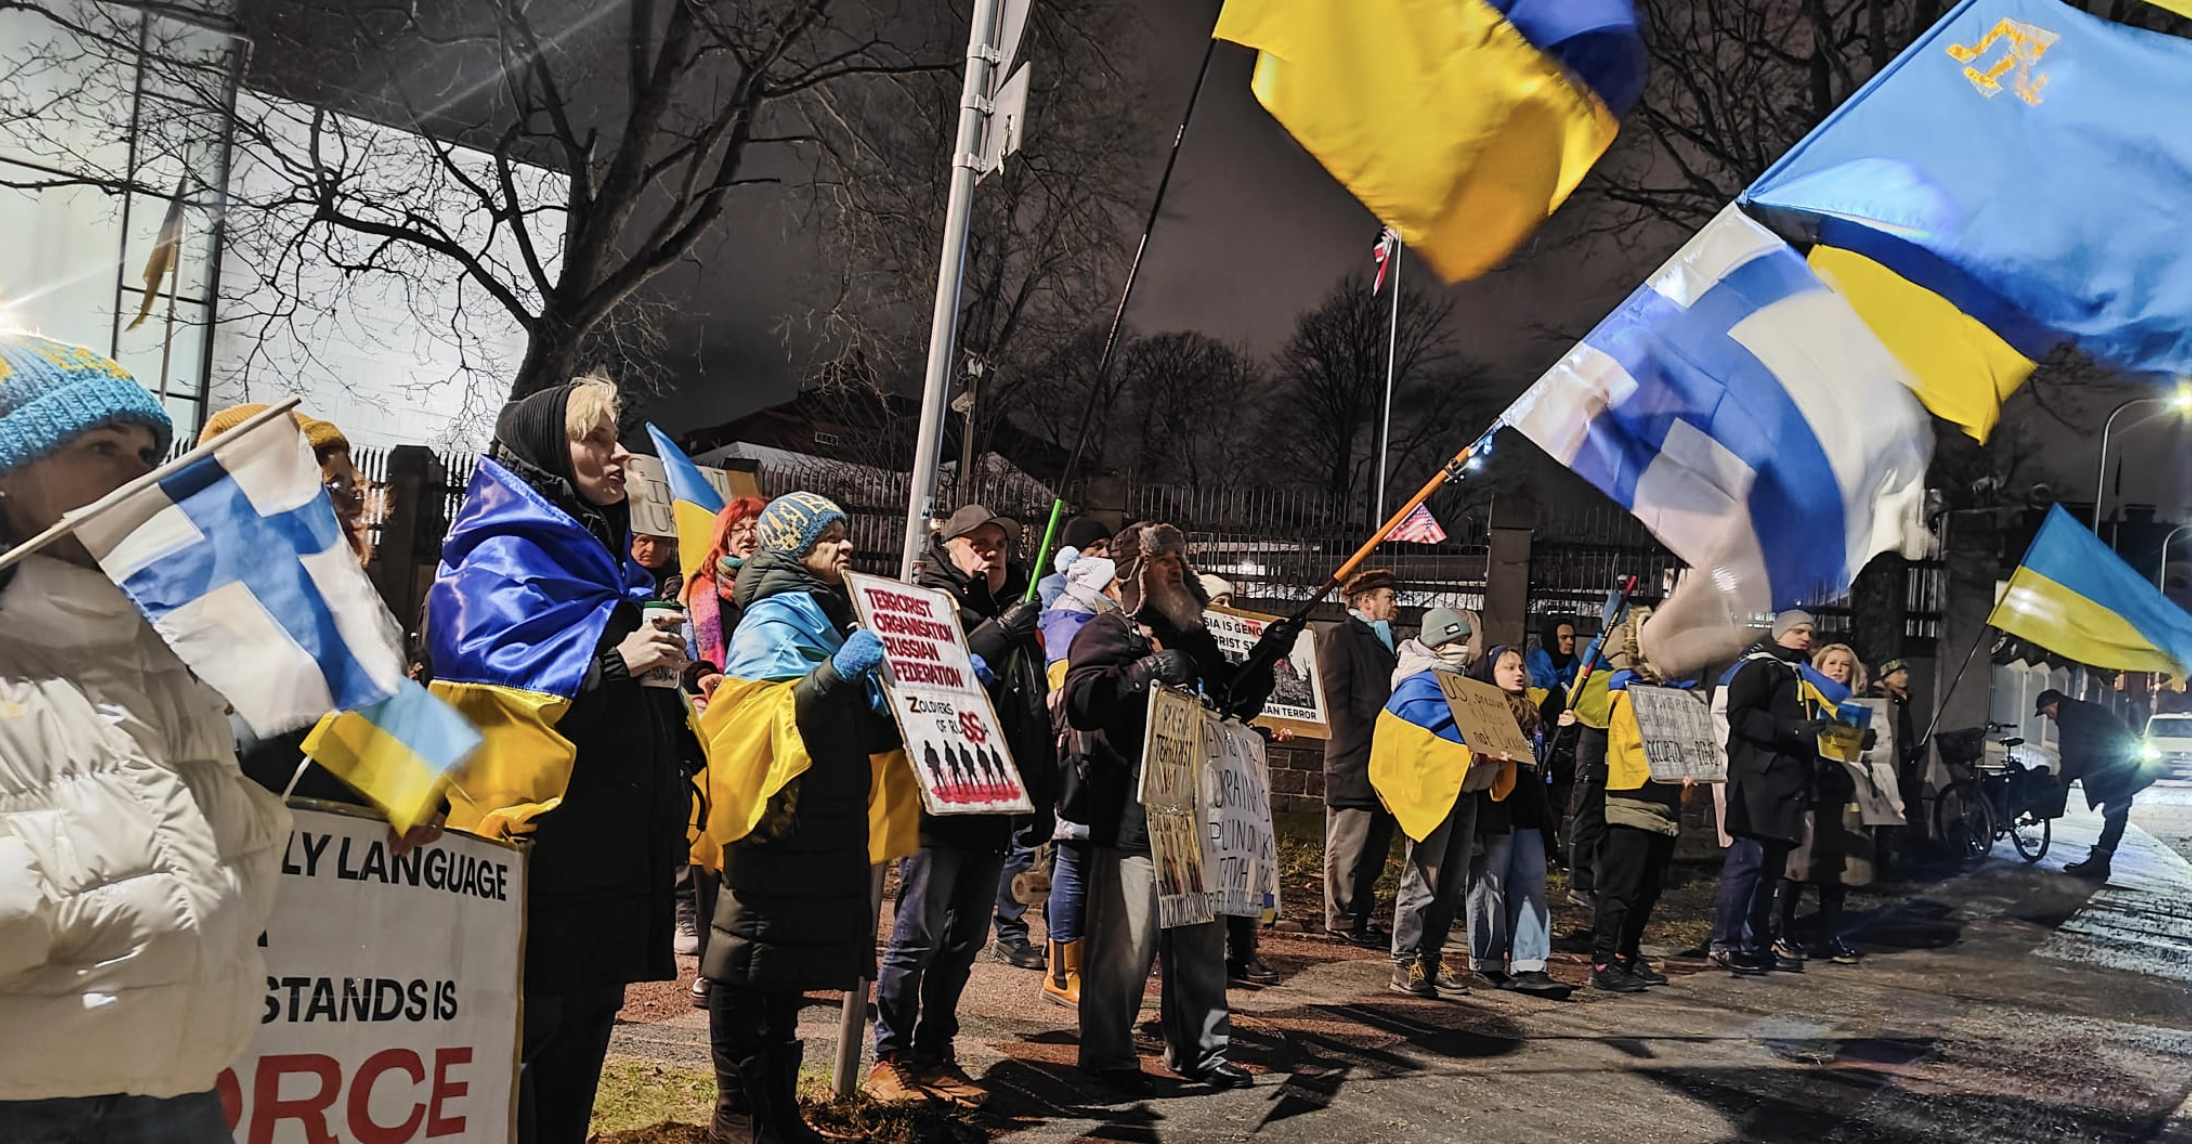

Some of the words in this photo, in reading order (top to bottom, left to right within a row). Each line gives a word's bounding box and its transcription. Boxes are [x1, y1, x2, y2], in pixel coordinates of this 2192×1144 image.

[864, 588, 933, 618] TERRORIST
[873, 612, 955, 645] ORGANISATION
[1223, 621, 1232, 631] IS
[882, 636, 941, 661] RUSSIAN
[891, 660, 964, 688] FEDERATION
[1440, 675, 1467, 702] US
[905, 696, 954, 716] ZOLDIERS
[1282, 707, 1317, 720] TERROR
[337, 837, 507, 901] LANGUAGE
[434, 980, 458, 1021] IS
